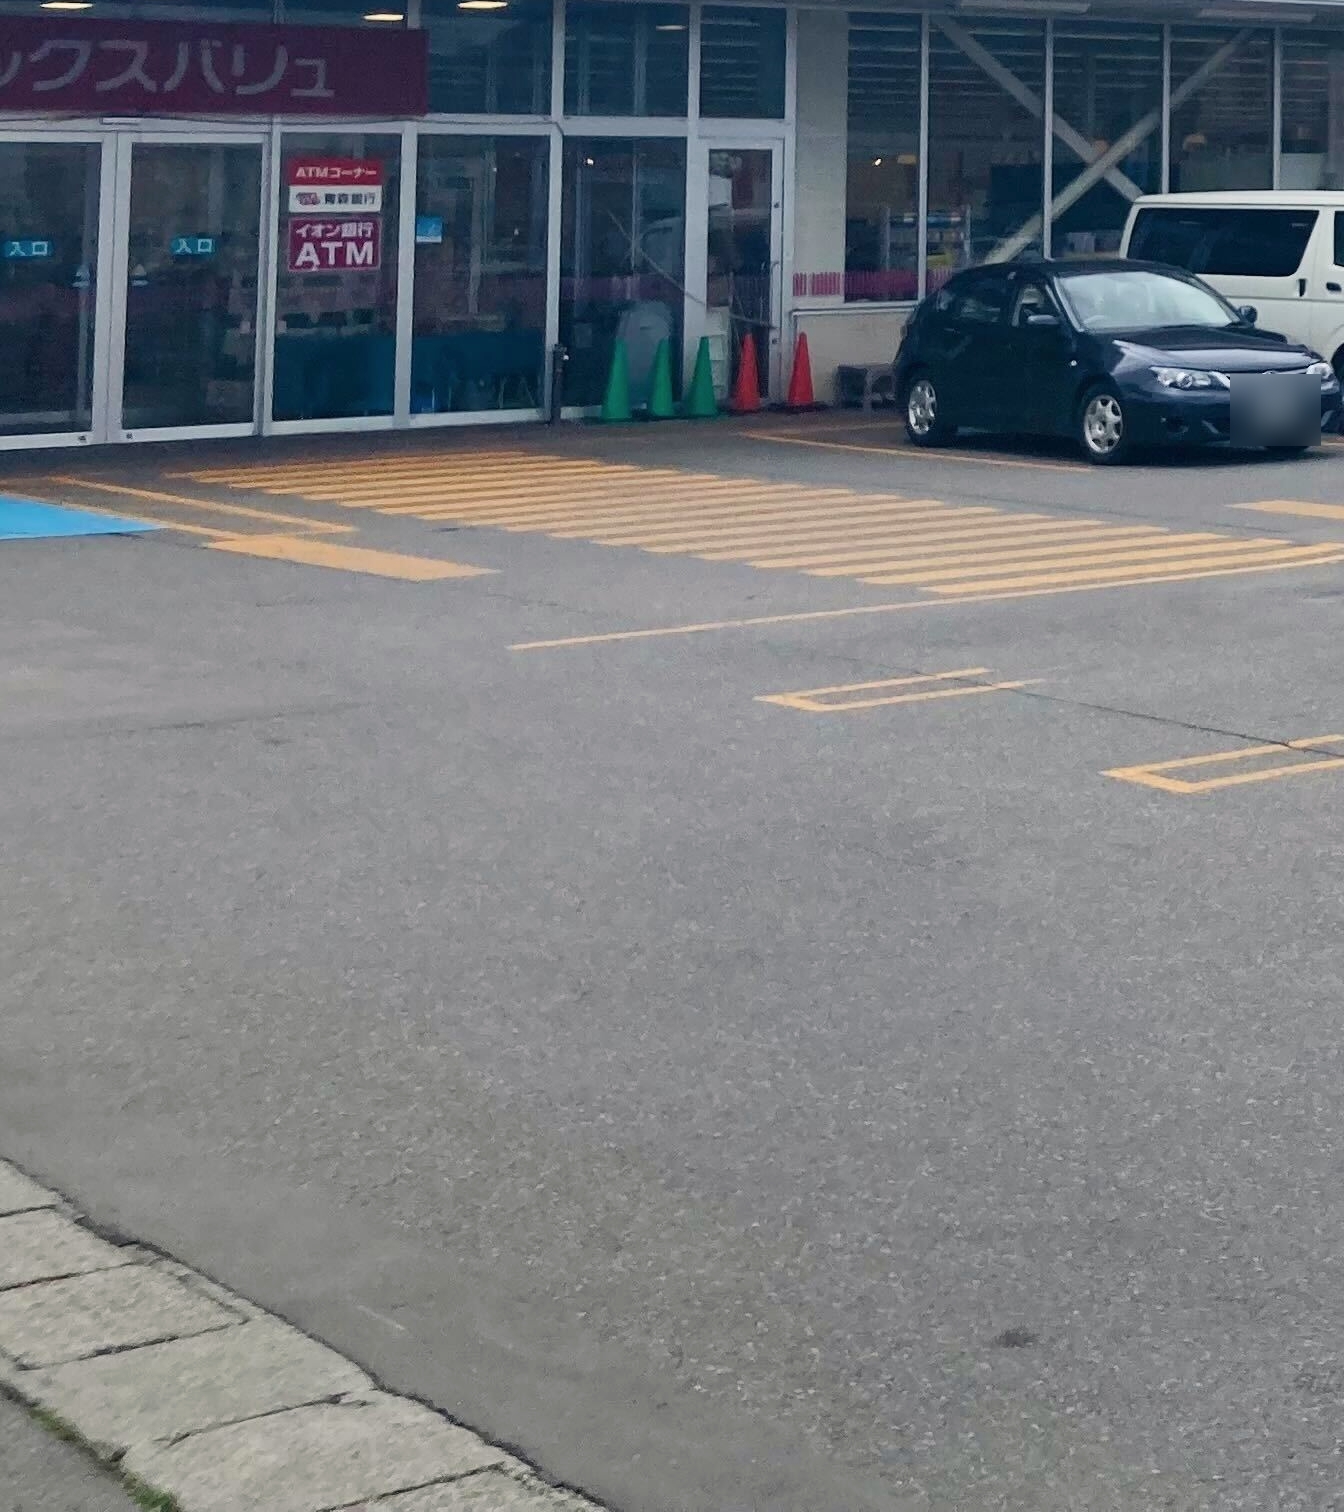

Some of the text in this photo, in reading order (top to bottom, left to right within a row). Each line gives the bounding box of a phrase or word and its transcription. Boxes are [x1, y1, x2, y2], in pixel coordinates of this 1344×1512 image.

[296, 167, 376, 179] ATMコーナー
[296, 222, 374, 238] イオン銀行
[10, 241, 48, 257] 入口
[176, 238, 212, 253] 入口
[295, 241, 373, 265] ATM
